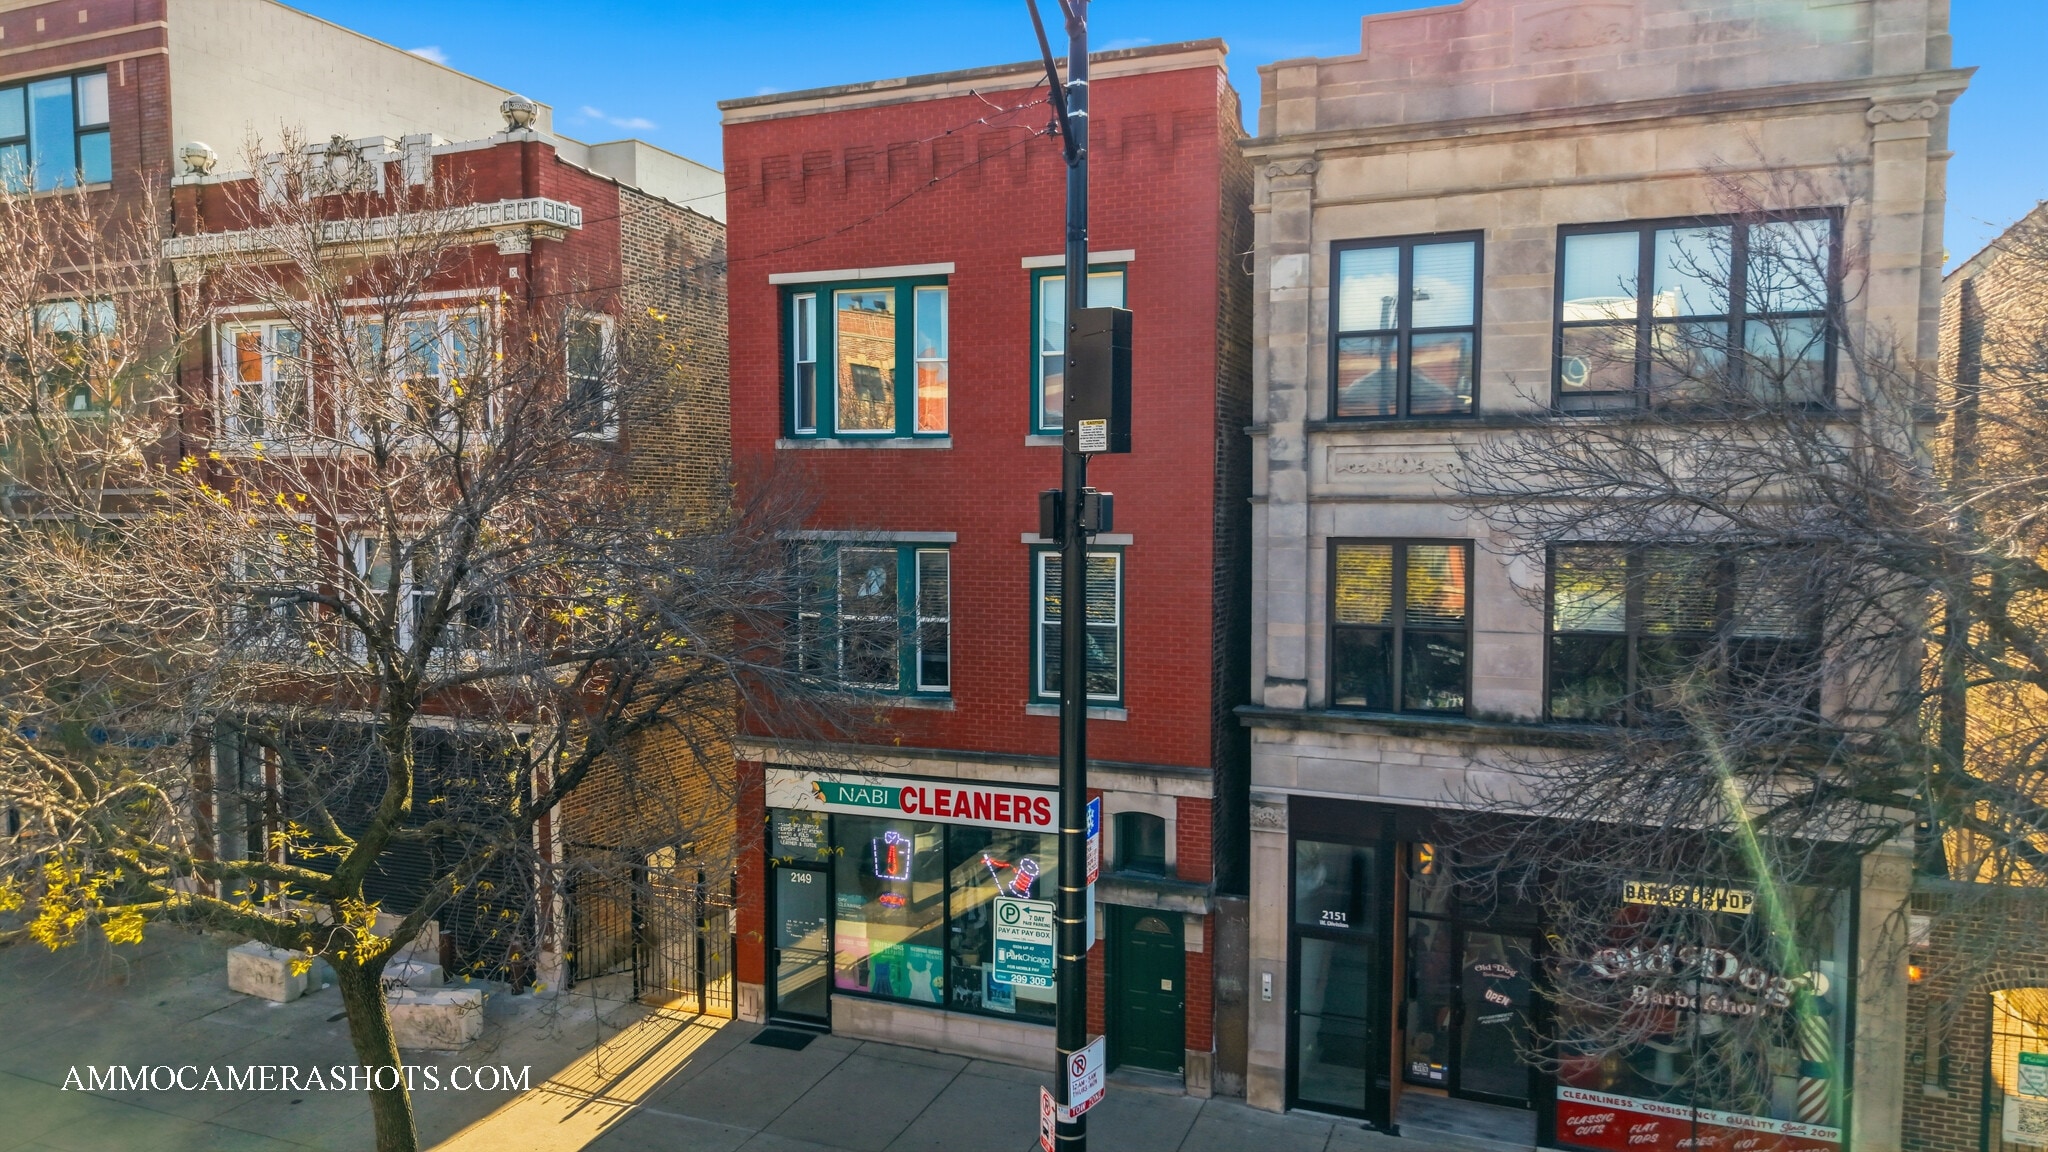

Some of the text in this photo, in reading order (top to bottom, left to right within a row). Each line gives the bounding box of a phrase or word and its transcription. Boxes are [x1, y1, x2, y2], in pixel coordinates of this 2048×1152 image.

[839, 786, 1052, 826] NABI CLEANERS
[790, 872, 812, 884] 2149
[1322, 910, 1346, 921] 2151
[1006, 950, 1050, 965] ParkChicago
[1493, 964, 1517, 977] Dog
[1010, 974, 1046, 986] 299 309
[1485, 989, 1511, 1006] OPEN
[1563, 1090, 1633, 1107] CLEANLINESS
[1726, 1117, 1775, 1129] QUALITY
[1780, 1122, 1807, 1133] Since
[1810, 1128, 1837, 1139] 2019
[1566, 1113, 1615, 1125] CLASSIC
[1575, 1125, 1606, 1135] CUTS
[1628, 1122, 1659, 1133] FLAT
[1628, 1133, 1659, 1144] TOPS
